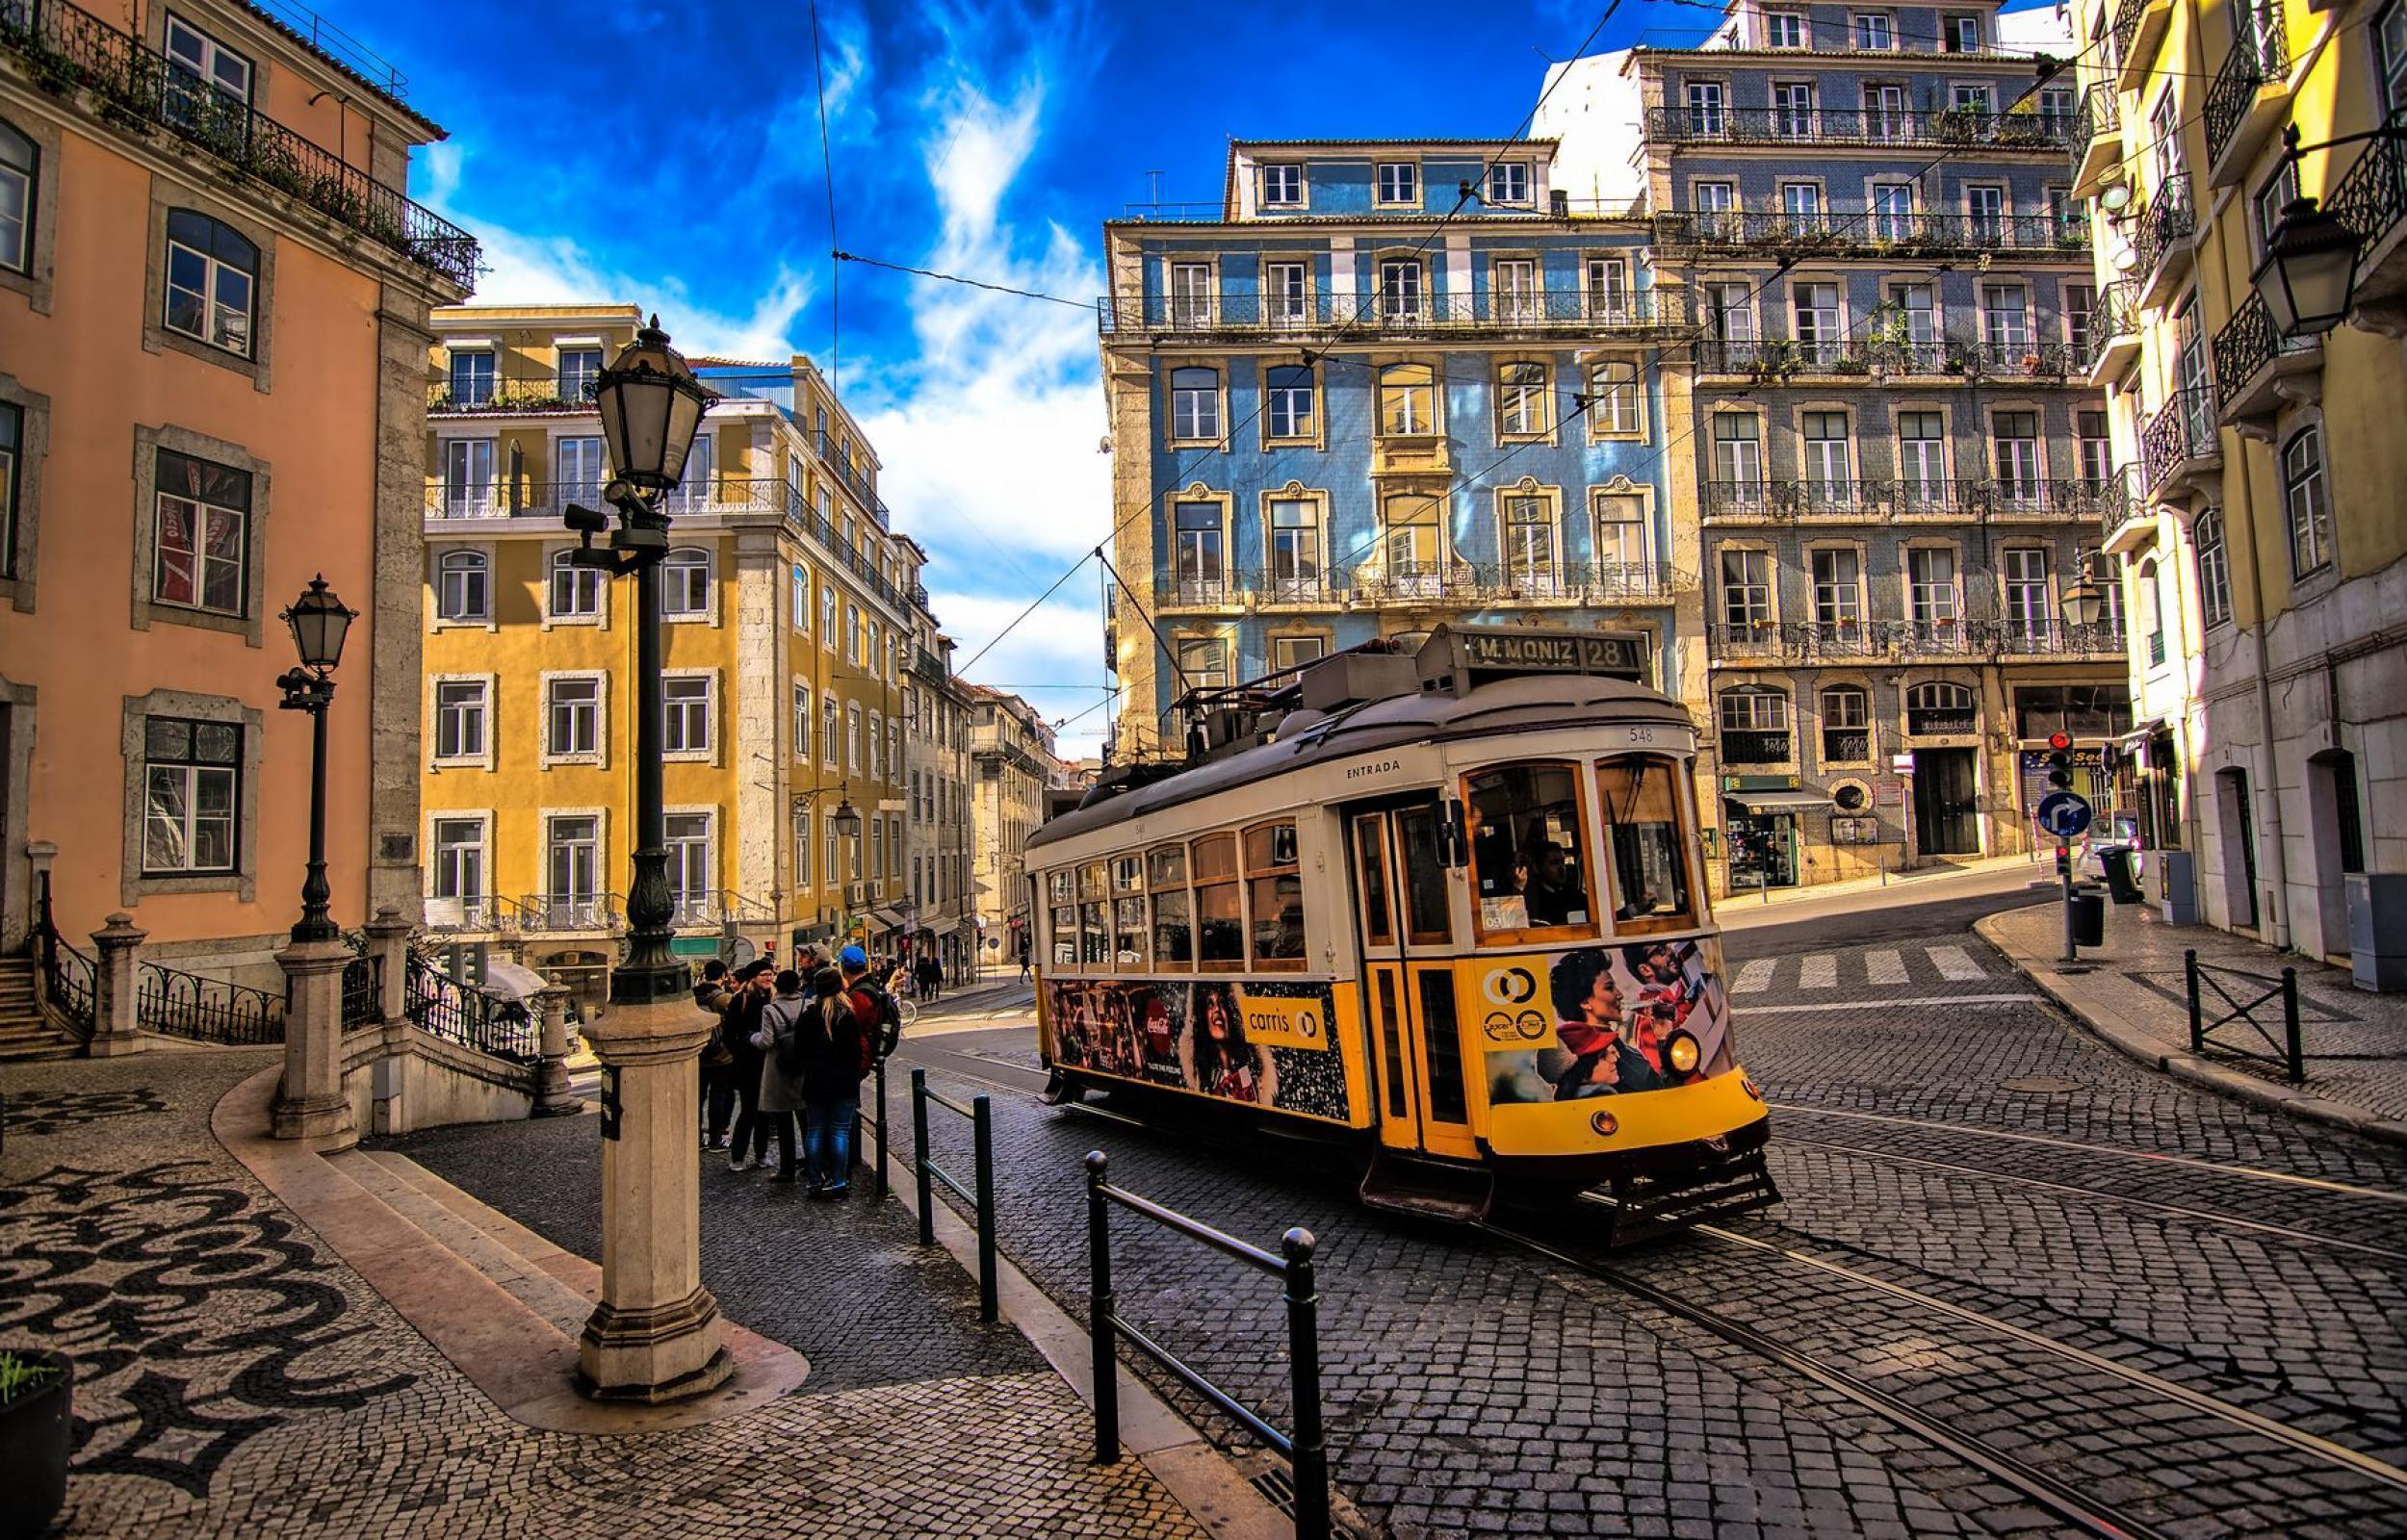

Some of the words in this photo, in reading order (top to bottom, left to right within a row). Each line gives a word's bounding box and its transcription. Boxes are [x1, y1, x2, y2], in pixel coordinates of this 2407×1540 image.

[1589, 641, 1620, 665] 28
[1629, 728, 1653, 743] 548
[1347, 759, 1400, 779] ENTRADA
[1250, 1007, 1289, 1032] carris
